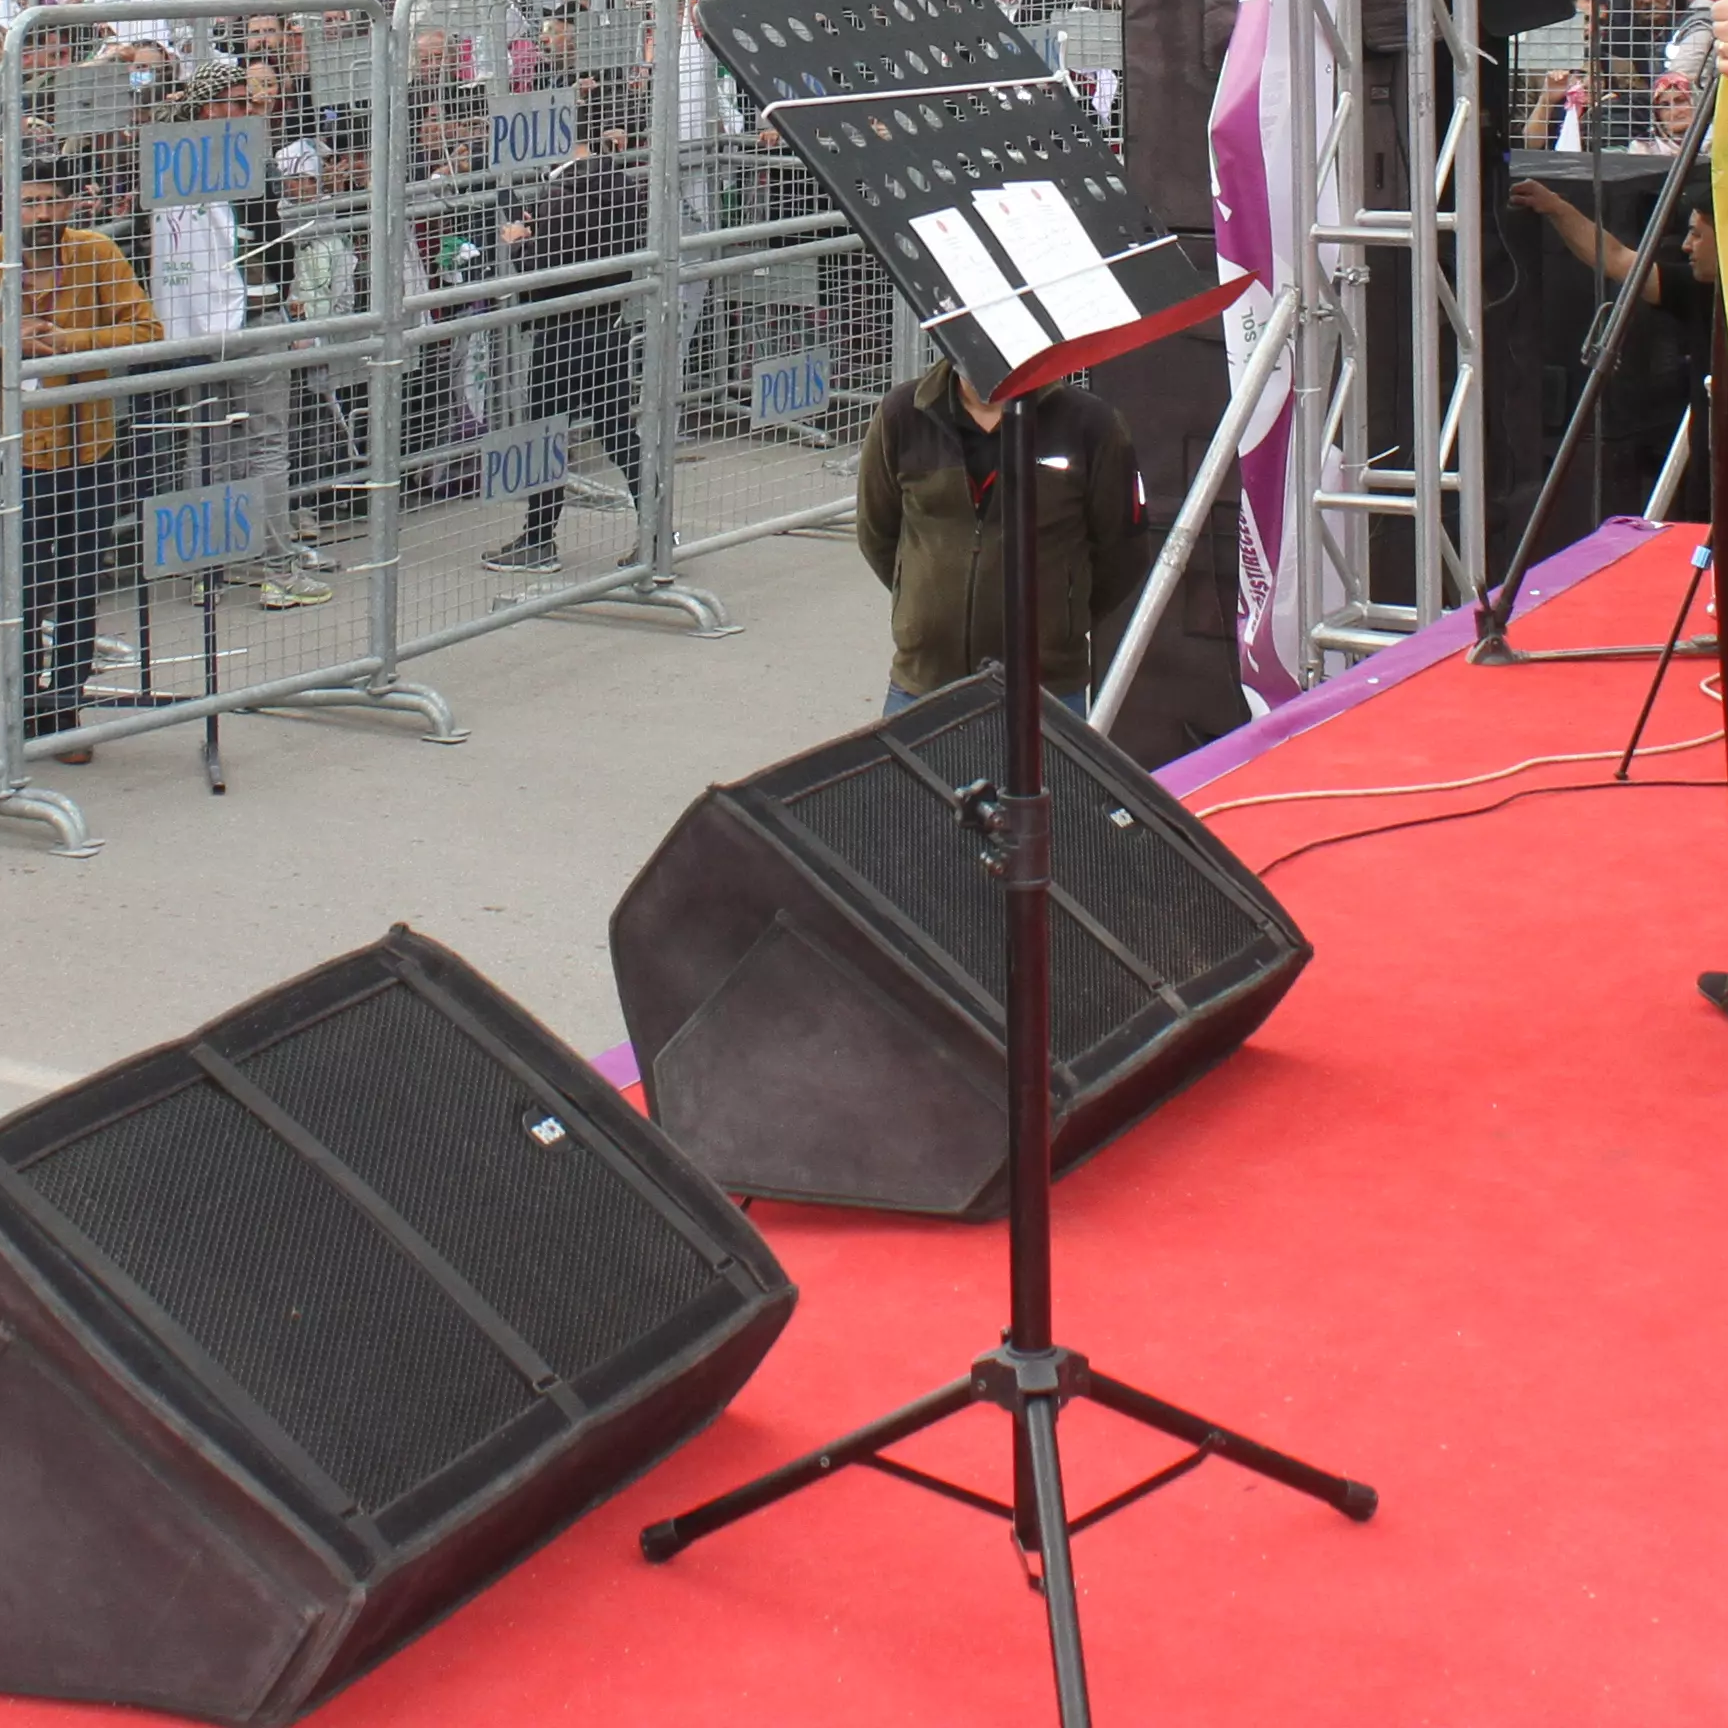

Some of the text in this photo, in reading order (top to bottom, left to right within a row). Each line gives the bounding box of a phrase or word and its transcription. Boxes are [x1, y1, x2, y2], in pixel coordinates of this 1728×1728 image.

[153, 122, 251, 199] POLİS
[492, 103, 572, 165] POLİS
[760, 355, 827, 420] POLİS
[485, 426, 566, 494] POLİS
[154, 485, 250, 566] POLİS
[531, 1117, 566, 1145] RCF
